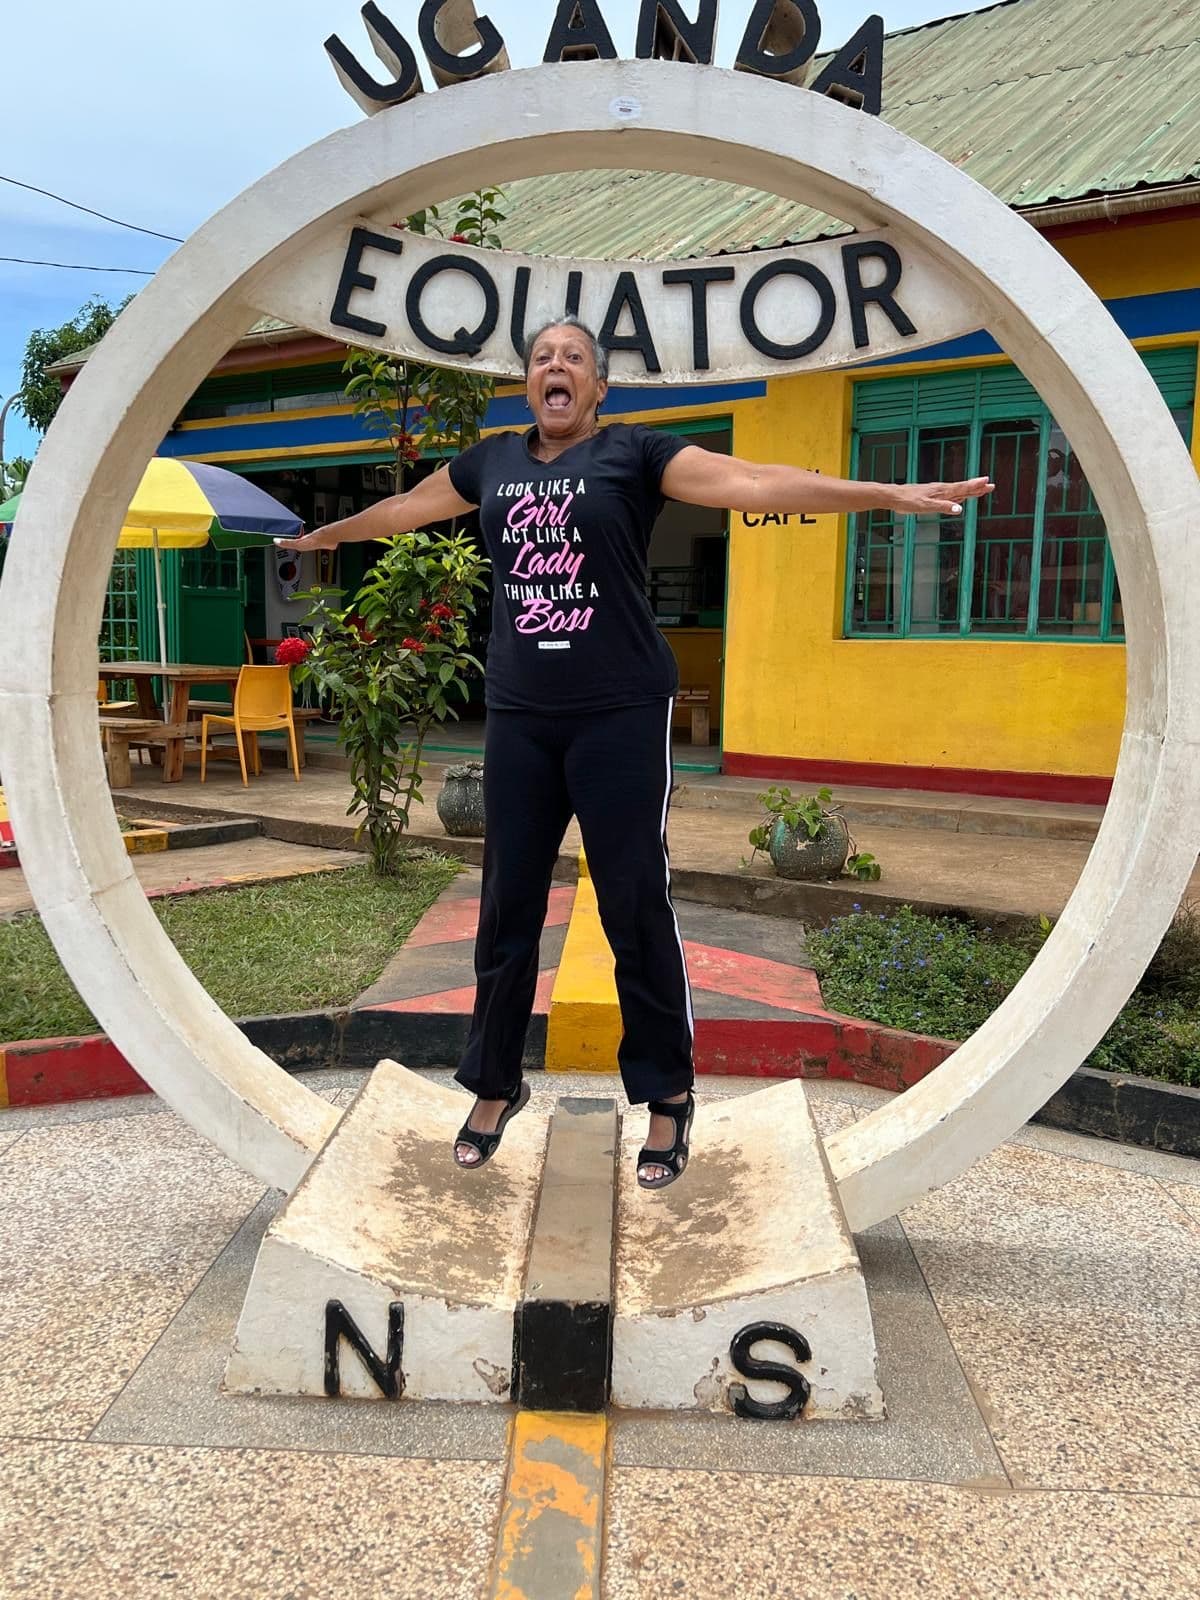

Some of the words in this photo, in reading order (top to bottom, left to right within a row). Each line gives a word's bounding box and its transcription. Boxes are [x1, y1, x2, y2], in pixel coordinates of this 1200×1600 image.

[323, 0, 885, 116] UGANDA
[330, 227, 917, 373] EQUATOR
[497, 482, 534, 497] LOOK
[538, 479, 571, 496] LIKE
[576, 478, 586, 494] A
[507, 491, 574, 529] Girl
[502, 527, 528, 543] ACT
[536, 527, 566, 543] LIKE
[573, 527, 582, 543] A
[509, 541, 585, 589] Lady
[504, 584, 544, 600] THINK
[550, 583, 583, 600] LIKE
[590, 582, 599, 598] A
[515, 598, 595, 634] Boss
[325, 1300, 404, 1399] N
[729, 1320, 811, 1420] S
